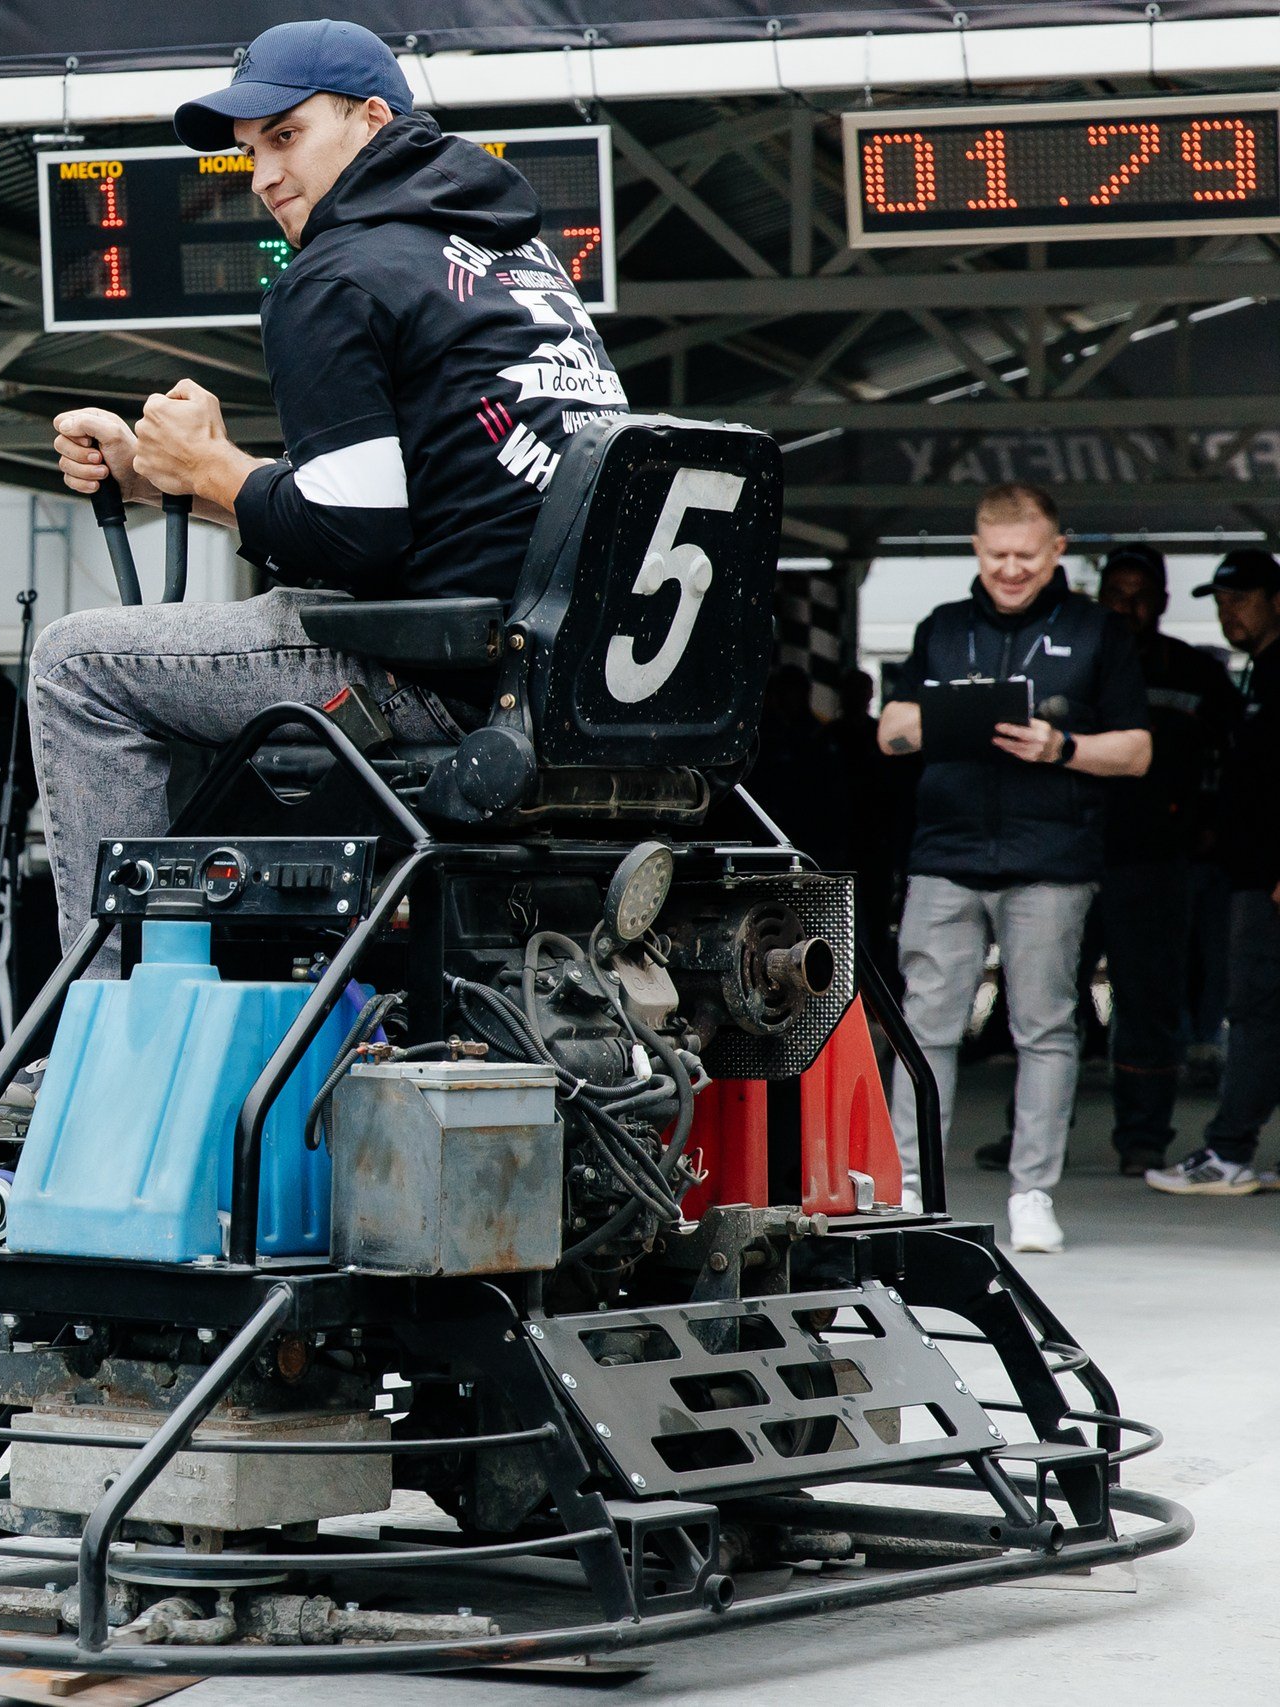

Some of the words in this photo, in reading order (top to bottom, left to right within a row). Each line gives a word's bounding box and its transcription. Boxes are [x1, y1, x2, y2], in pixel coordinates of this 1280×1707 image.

[60, 160, 124, 180] МЕСТО
[199, 154, 256, 174] НОМЕ
[863, 117, 1257, 213] 01.79
[99, 175, 125, 228] 1
[103, 245, 128, 298] 1
[509, 269, 562, 290] FINISHER
[552, 366, 607, 395] don't
[605, 467, 747, 704] 5
